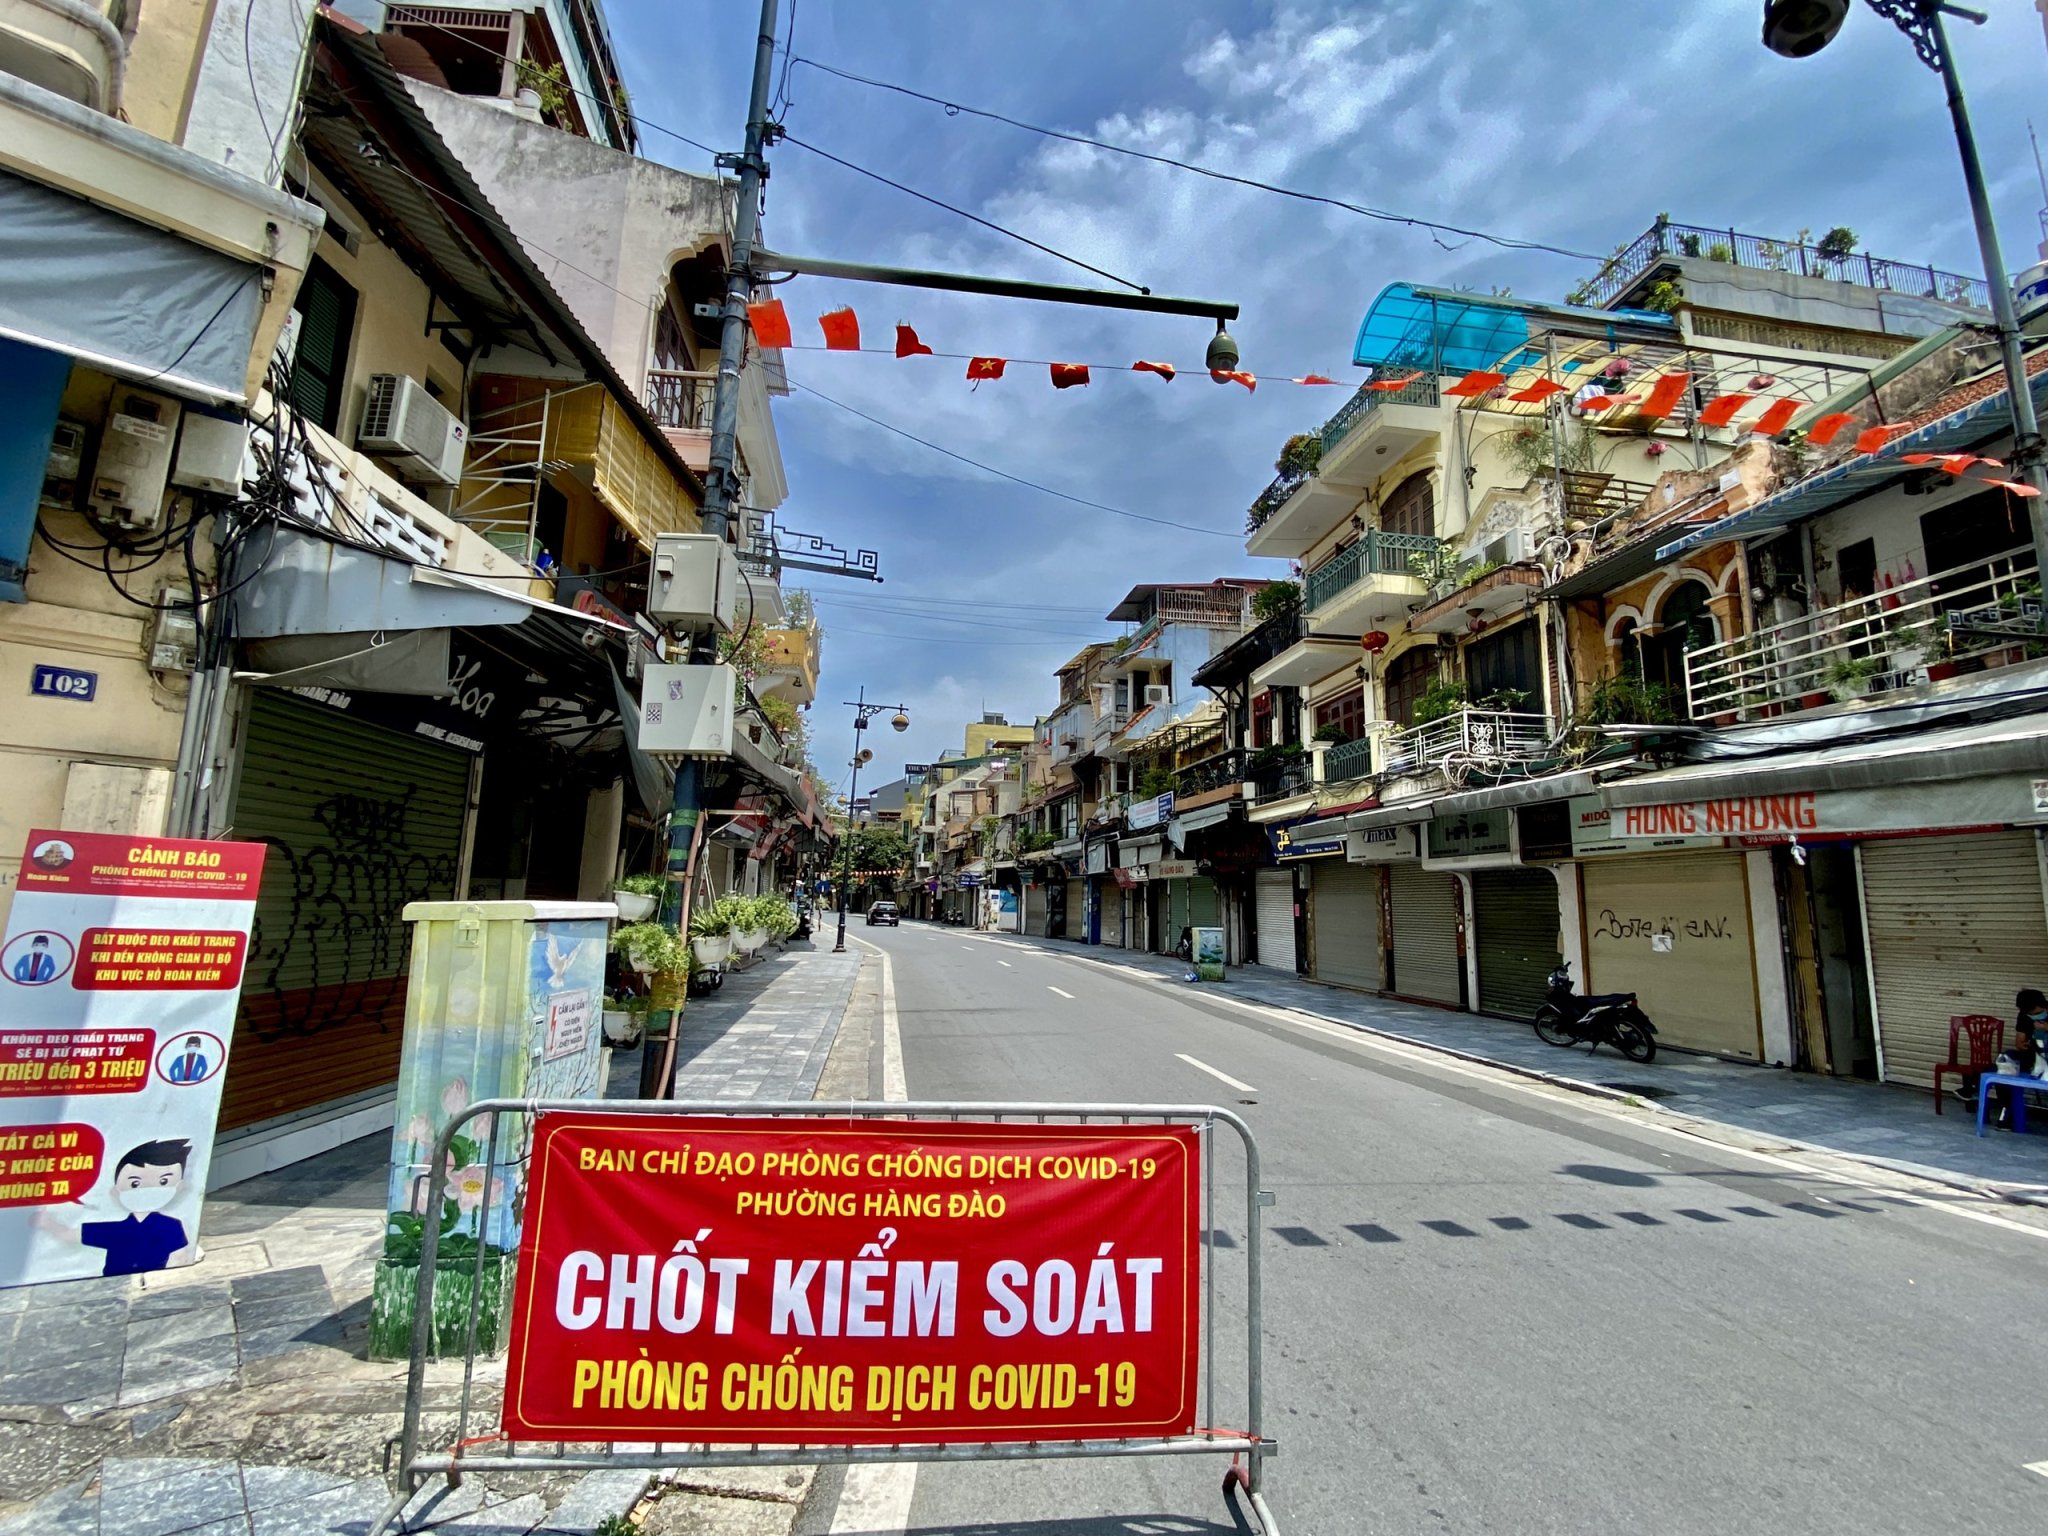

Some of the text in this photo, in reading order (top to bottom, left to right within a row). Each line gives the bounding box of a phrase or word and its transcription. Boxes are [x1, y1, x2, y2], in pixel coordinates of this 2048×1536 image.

[39, 673, 89, 695] 102
[128, 844, 221, 867] CẢNH BÁO
[91, 865, 129, 877] PHÒNG
[131, 865, 168, 879] CHỐNG
[170, 870, 194, 881] DỊCH
[196, 871, 226, 881] COVID
[235, 873, 248, 882] 19
[117, 933, 148, 948] BUỘC
[203, 936, 237, 948] TRANG
[90, 951, 111, 963] KHI
[136, 951, 173, 964] KHÔNG
[175, 953, 202, 964] GIAN
[216, 951, 232, 966] BỘ
[95, 969, 119, 981] KHU
[121, 969, 144, 984] VỰC
[163, 968, 193, 981] HOÀN
[1, 1034, 43, 1045] KHÔNG
[107, 1033, 145, 1043] TRANG
[35, 1047, 49, 1060] BỊ
[72, 1046, 106, 1059] PHẠT
[0, 1057, 147, 1084] TRIỆU đến 3 TRIỆU
[32, 1130, 55, 1150] CẢ
[60, 1130, 79, 1148] VÌ
[59, 1152, 94, 1172] CỦA
[579, 1144, 1157, 1185] BAN CHỈ ĐẠO PHÒNG CHỐNG DỊCH COVID-19
[0, 1180, 70, 1200] HÚNG TA
[736, 1187, 1006, 1218] PHƯỜNG HÀNG ĐÀO
[555, 1226, 1163, 1337] CHỐT KIỂM SOÁT
[572, 1346, 1137, 1421] PHÒNG CHỐNG DỊCH COVID-19
